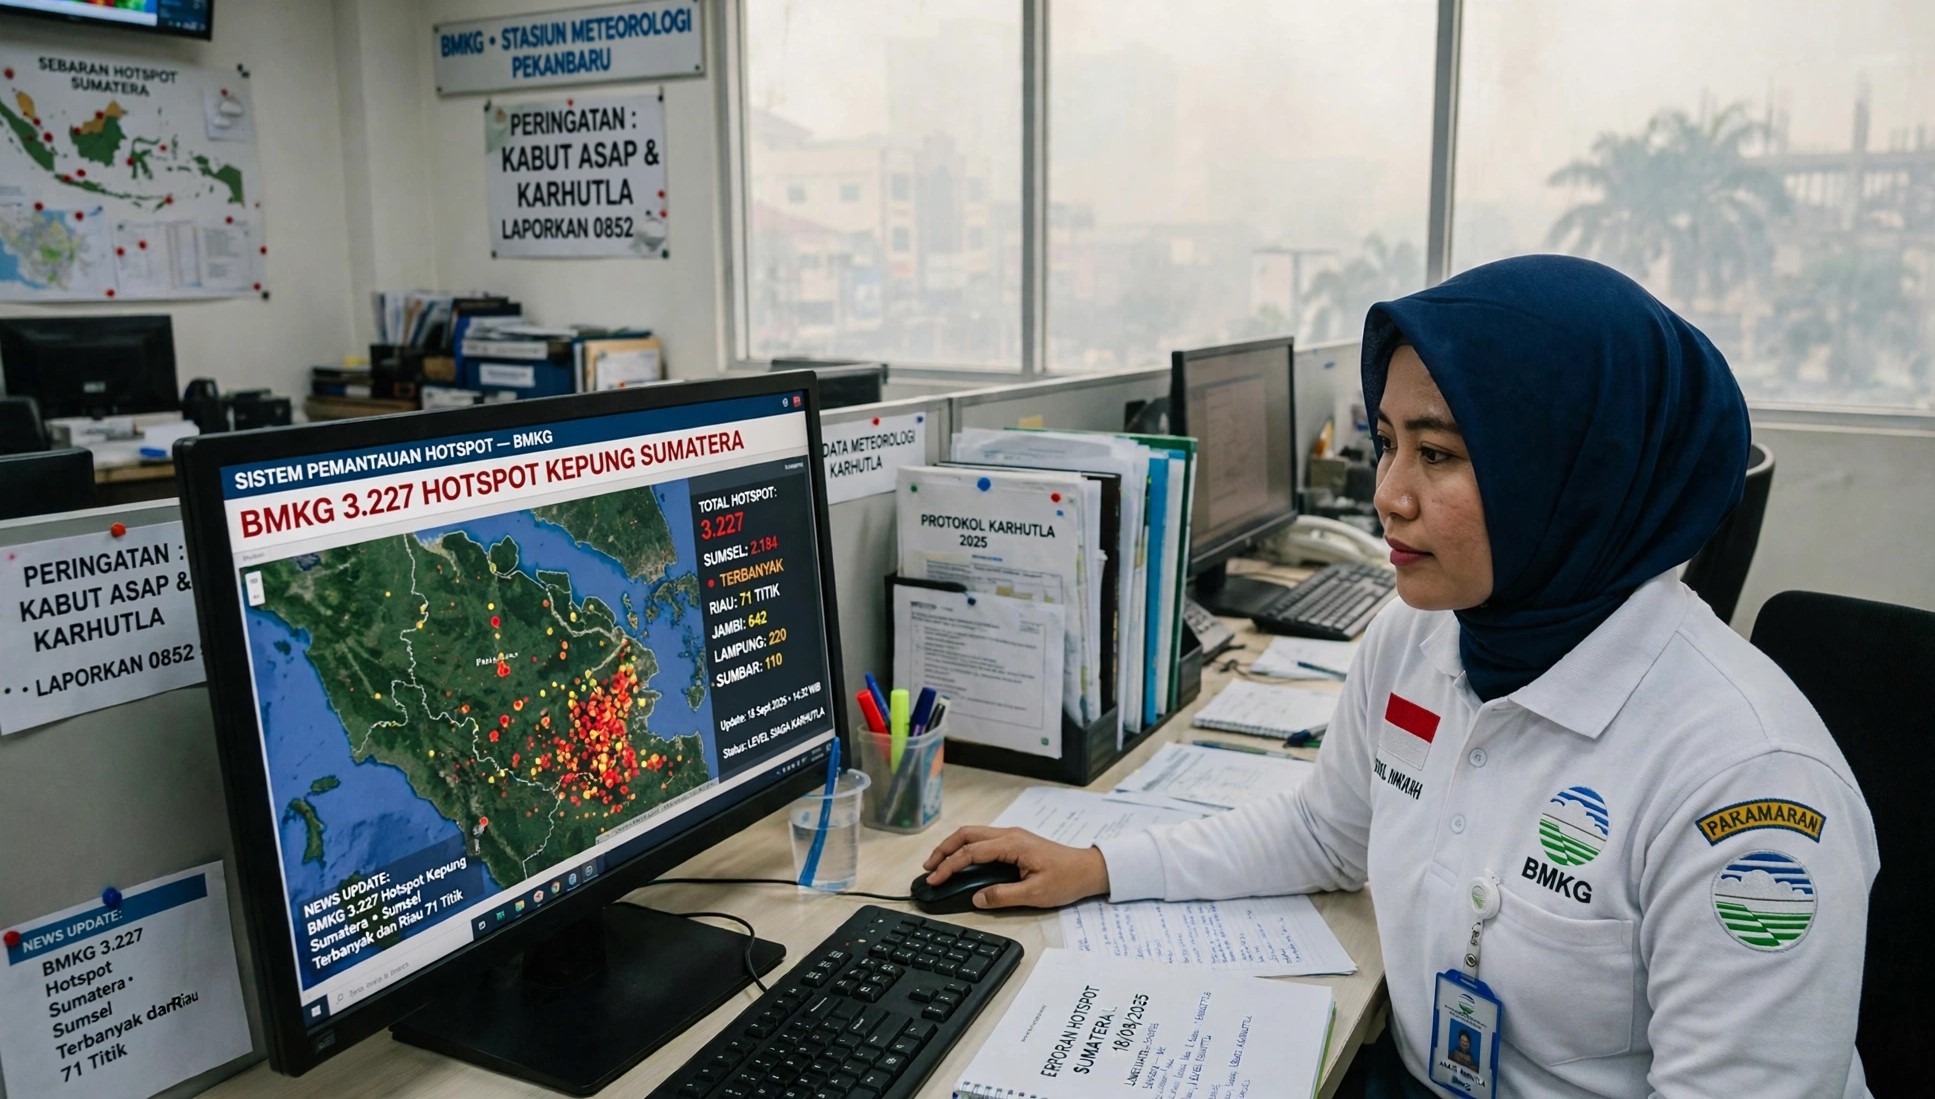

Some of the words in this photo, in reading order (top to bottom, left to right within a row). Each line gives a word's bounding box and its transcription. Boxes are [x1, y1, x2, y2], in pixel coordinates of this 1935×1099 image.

[440, 31, 484, 58] BMKG
[502, 21, 567, 51] STASIUN
[572, 8, 692, 43] METEOROLOGI
[38, 56, 109, 77] SEBARAN
[114, 65, 178, 84] HOTSPOT
[512, 48, 611, 78] PEKANBARU
[71, 76, 150, 97] SUMATERA
[510, 106, 625, 136] PERINGATAN
[502, 143, 572, 172] KABUT
[578, 140, 637, 169] ASAP
[644, 139, 660, 166] &
[517, 178, 633, 208] KARHUTLA
[502, 218, 588, 240] LAPORKAN
[593, 216, 634, 238] 0852
[851, 429, 915, 454] METEOROLOGI
[234, 464, 303, 491] SISTEM
[307, 448, 422, 480] PEMANTAUAN
[425, 437, 494, 462] HOTSPOT
[513, 429, 553, 449] BMKG
[830, 455, 883, 478] KARHUTLA
[240, 496, 334, 539] BMKG
[341, 483, 414, 520] 3.227
[422, 463, 539, 505] HOTSPOT
[546, 447, 635, 483] KEPUNG
[640, 430, 745, 467] SUMATERA
[698, 496, 730, 513] TOTAL
[731, 486, 777, 506] HOTSPOT:
[701, 511, 745, 540] 3.227
[921, 514, 985, 532] PROTOKOL
[989, 520, 1056, 538] KARHUTLA
[959, 534, 988, 549] 2025
[24, 543, 170, 588] PERINGATAN
[703, 544, 748, 567] SUMSEL:
[750, 535, 779, 555] 2.184
[720, 558, 784, 588] TERBANYAK
[19, 587, 103, 622] KABUT
[110, 575, 169, 605] ASAP
[176, 571, 192, 592] &
[709, 596, 738, 615] RIAU:
[739, 591, 752, 606] 71
[754, 583, 780, 602] TITIK
[33, 607, 165, 652] KARHUTLA
[711, 619, 746, 640] JAMBI:
[748, 610, 768, 628] 642
[714, 635, 767, 663] LAMPUNG:
[768, 628, 787, 646] 220
[36, 654, 143, 697] LAPORKAN
[148, 643, 195, 669] 0852
[716, 661, 763, 688] SUMBAR:
[765, 652, 783, 670] 110
[720, 713, 746, 732] Update:
[747, 731, 770, 749] LEVEL
[770, 721, 791, 739] SIAGA
[791, 706, 825, 730] KARHUTLA
[1706, 804, 1818, 837] PARAMARAN
[303, 893, 341, 918] NEWS
[342, 871, 391, 900] UPDATE:
[307, 910, 345, 936] BMKG
[347, 895, 379, 918] 3.227
[381, 874, 424, 903] Hotspot
[426, 856, 467, 883] Kepung
[1521, 856, 1593, 904] BMKG
[22, 930, 64, 953] NEWS
[66, 909, 123, 937] UPDATE:
[310, 918, 369, 952] Sumatera
[382, 892, 422, 920] Sumsel
[312, 931, 376, 969] Terbanyak
[376, 922, 398, 939] dan
[398, 910, 424, 929] Riau
[424, 901, 438, 916] 71
[440, 889, 464, 909] Titik
[42, 946, 96, 977] BMKG
[100, 927, 144, 956] 3.227
[45, 960, 114, 997] Hotspot
[48, 979, 127, 1018] Sumatera
[1070, 985, 1100, 1030] HOTSPOT
[52, 1001, 113, 1039] Sumsel
[56, 1013, 143, 1060] Terbanyak
[60, 1060, 82, 1083] 71
[87, 1042, 129, 1071] Titik
